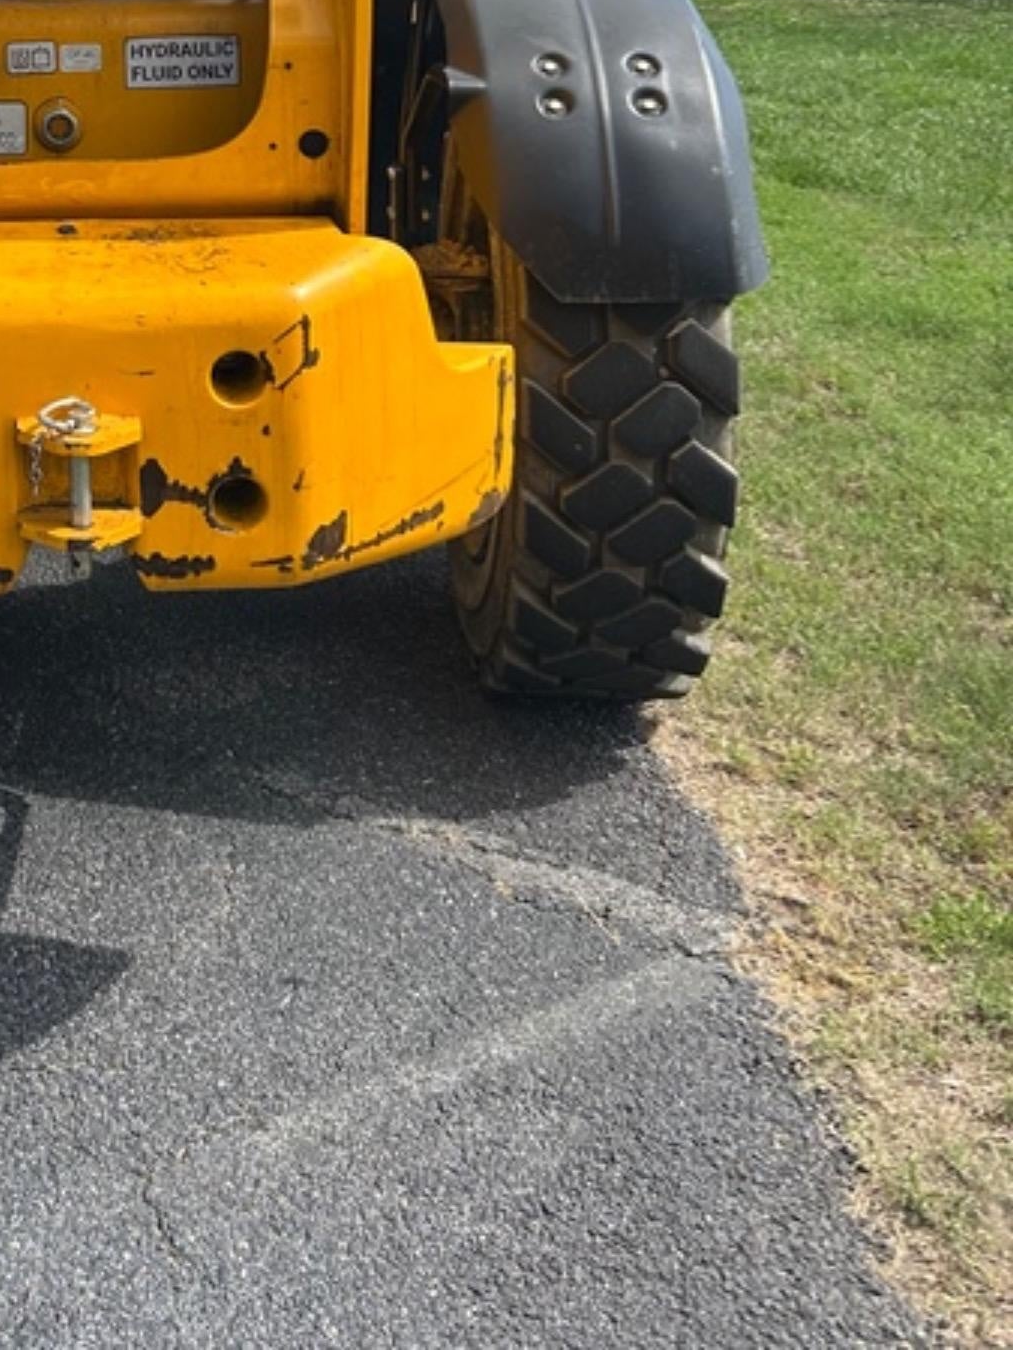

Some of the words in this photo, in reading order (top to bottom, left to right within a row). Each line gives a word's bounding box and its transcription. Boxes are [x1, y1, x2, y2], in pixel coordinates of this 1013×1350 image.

[131, 41, 234, 59] HYDRAULIC
[131, 65, 183, 82] FLUID
[187, 63, 234, 80] ONLY
